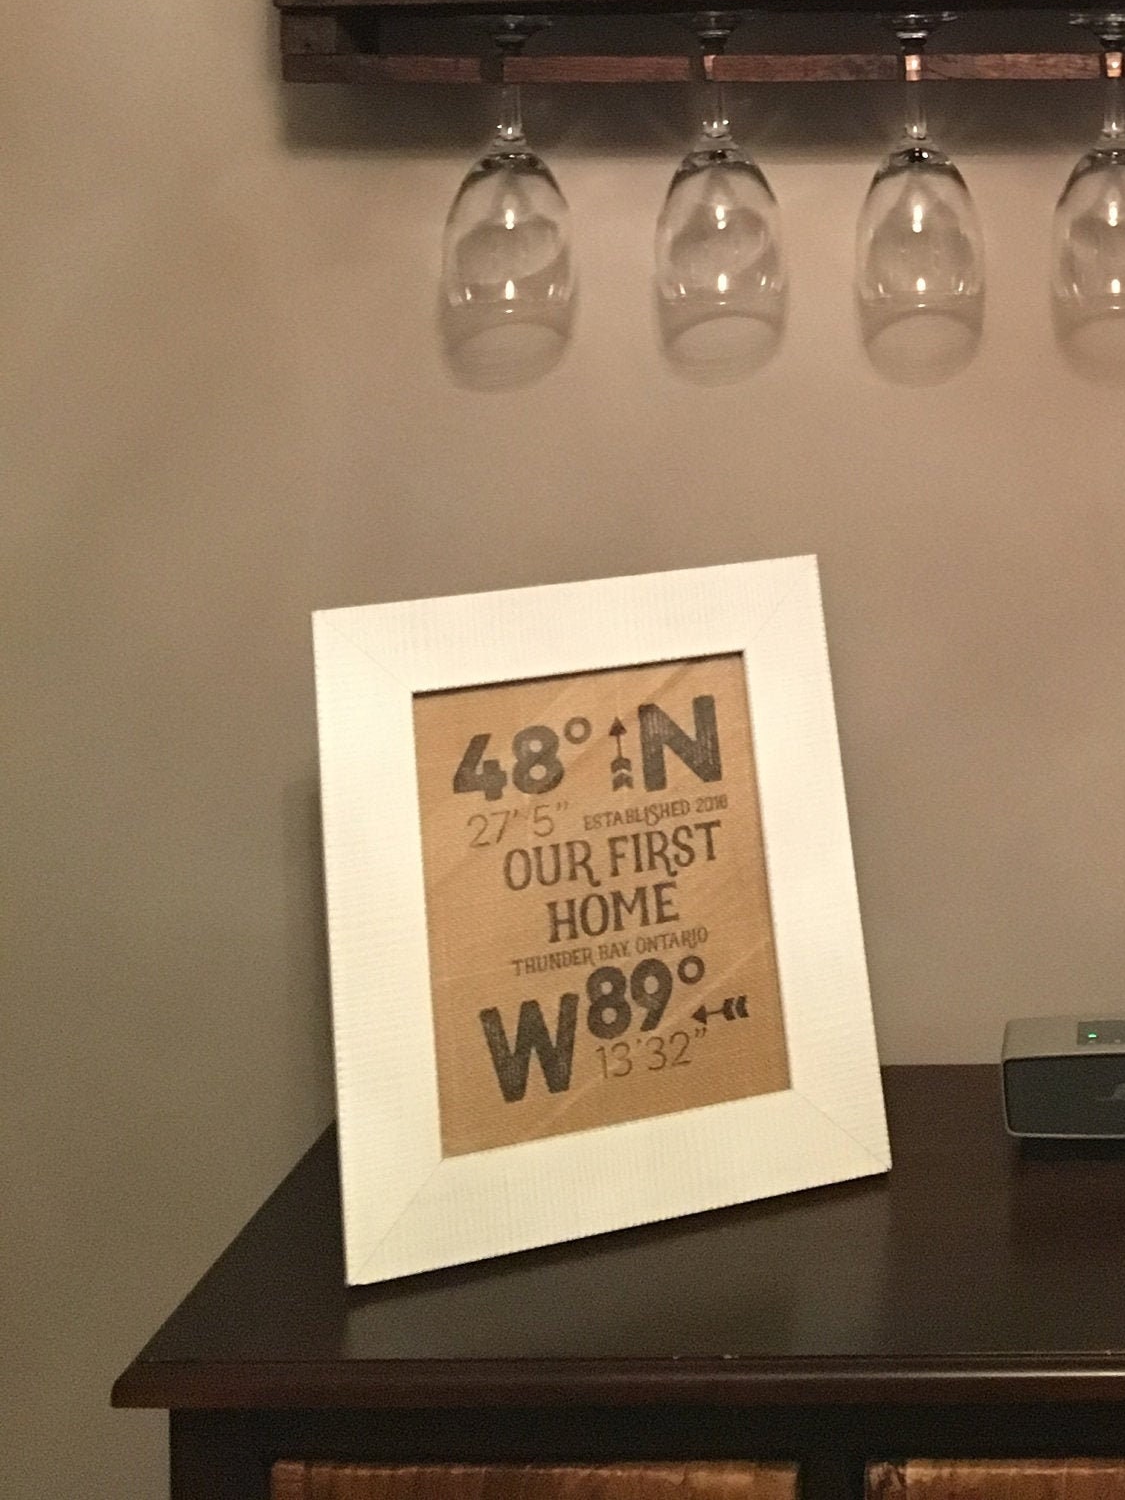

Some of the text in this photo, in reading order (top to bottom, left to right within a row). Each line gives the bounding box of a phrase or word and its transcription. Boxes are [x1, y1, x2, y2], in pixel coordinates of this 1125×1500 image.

[638, 694, 723, 793] N
[583, 799, 691, 828] ESTABLISHED
[503, 819, 722, 892] OUR FIRST
[546, 881, 680, 944] HOME
[511, 947, 596, 976] THUNDER
[635, 926, 709, 955] ONTARIO
